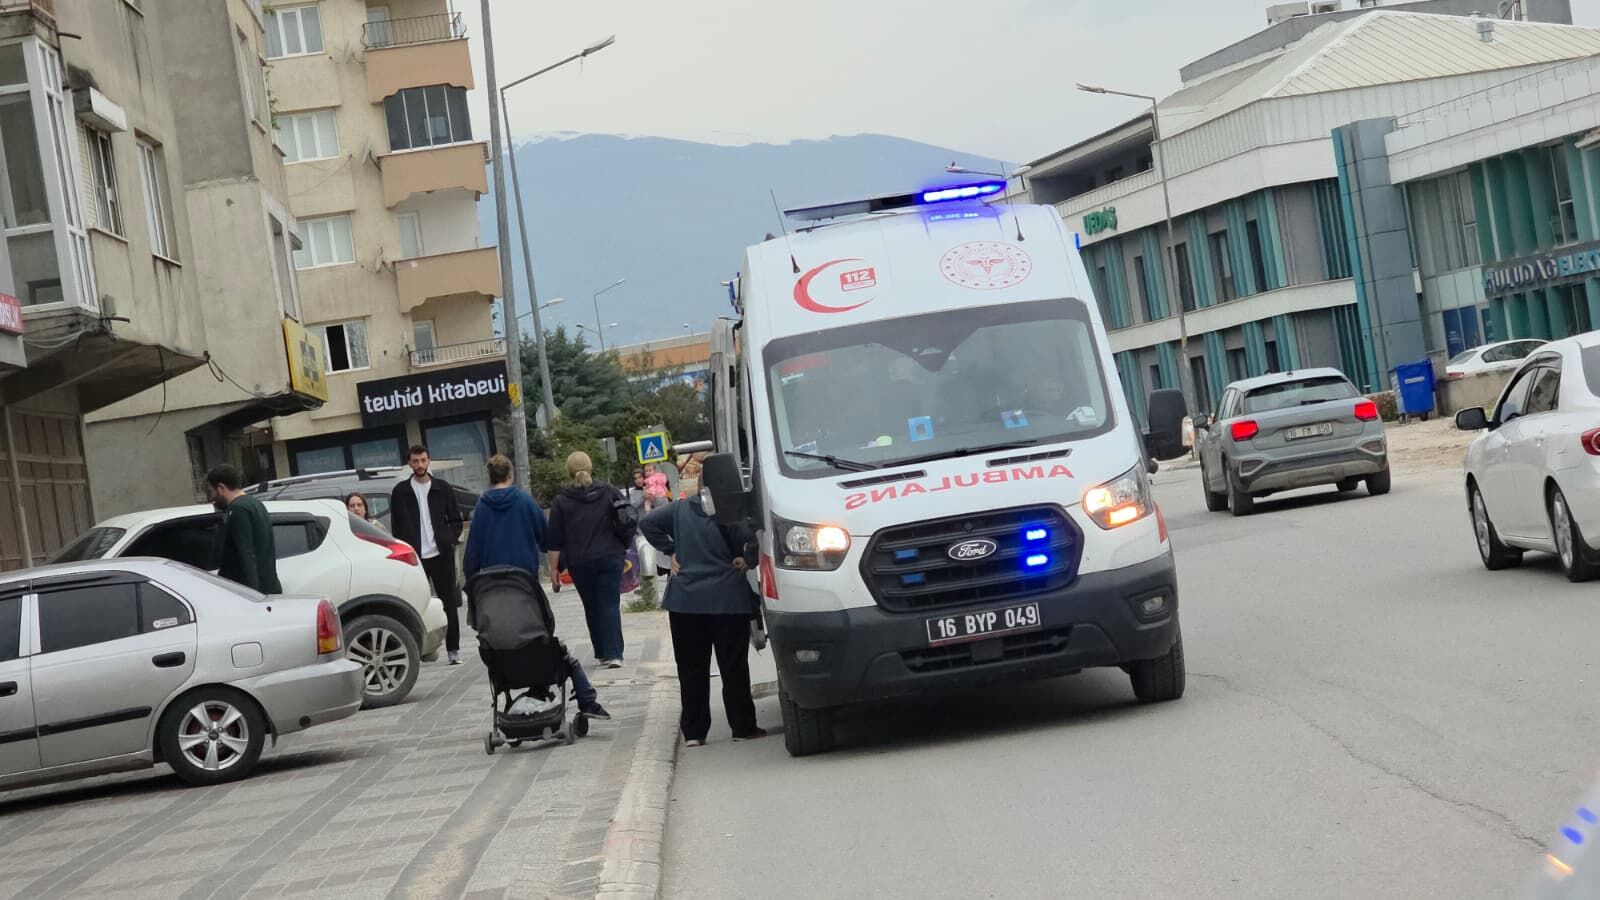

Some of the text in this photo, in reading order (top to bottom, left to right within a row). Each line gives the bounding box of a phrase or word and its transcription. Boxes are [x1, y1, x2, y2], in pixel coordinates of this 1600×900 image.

[846, 270, 870, 284] 112
[958, 543, 987, 557] Ford
[937, 605, 1037, 638] 16 BYP 049
